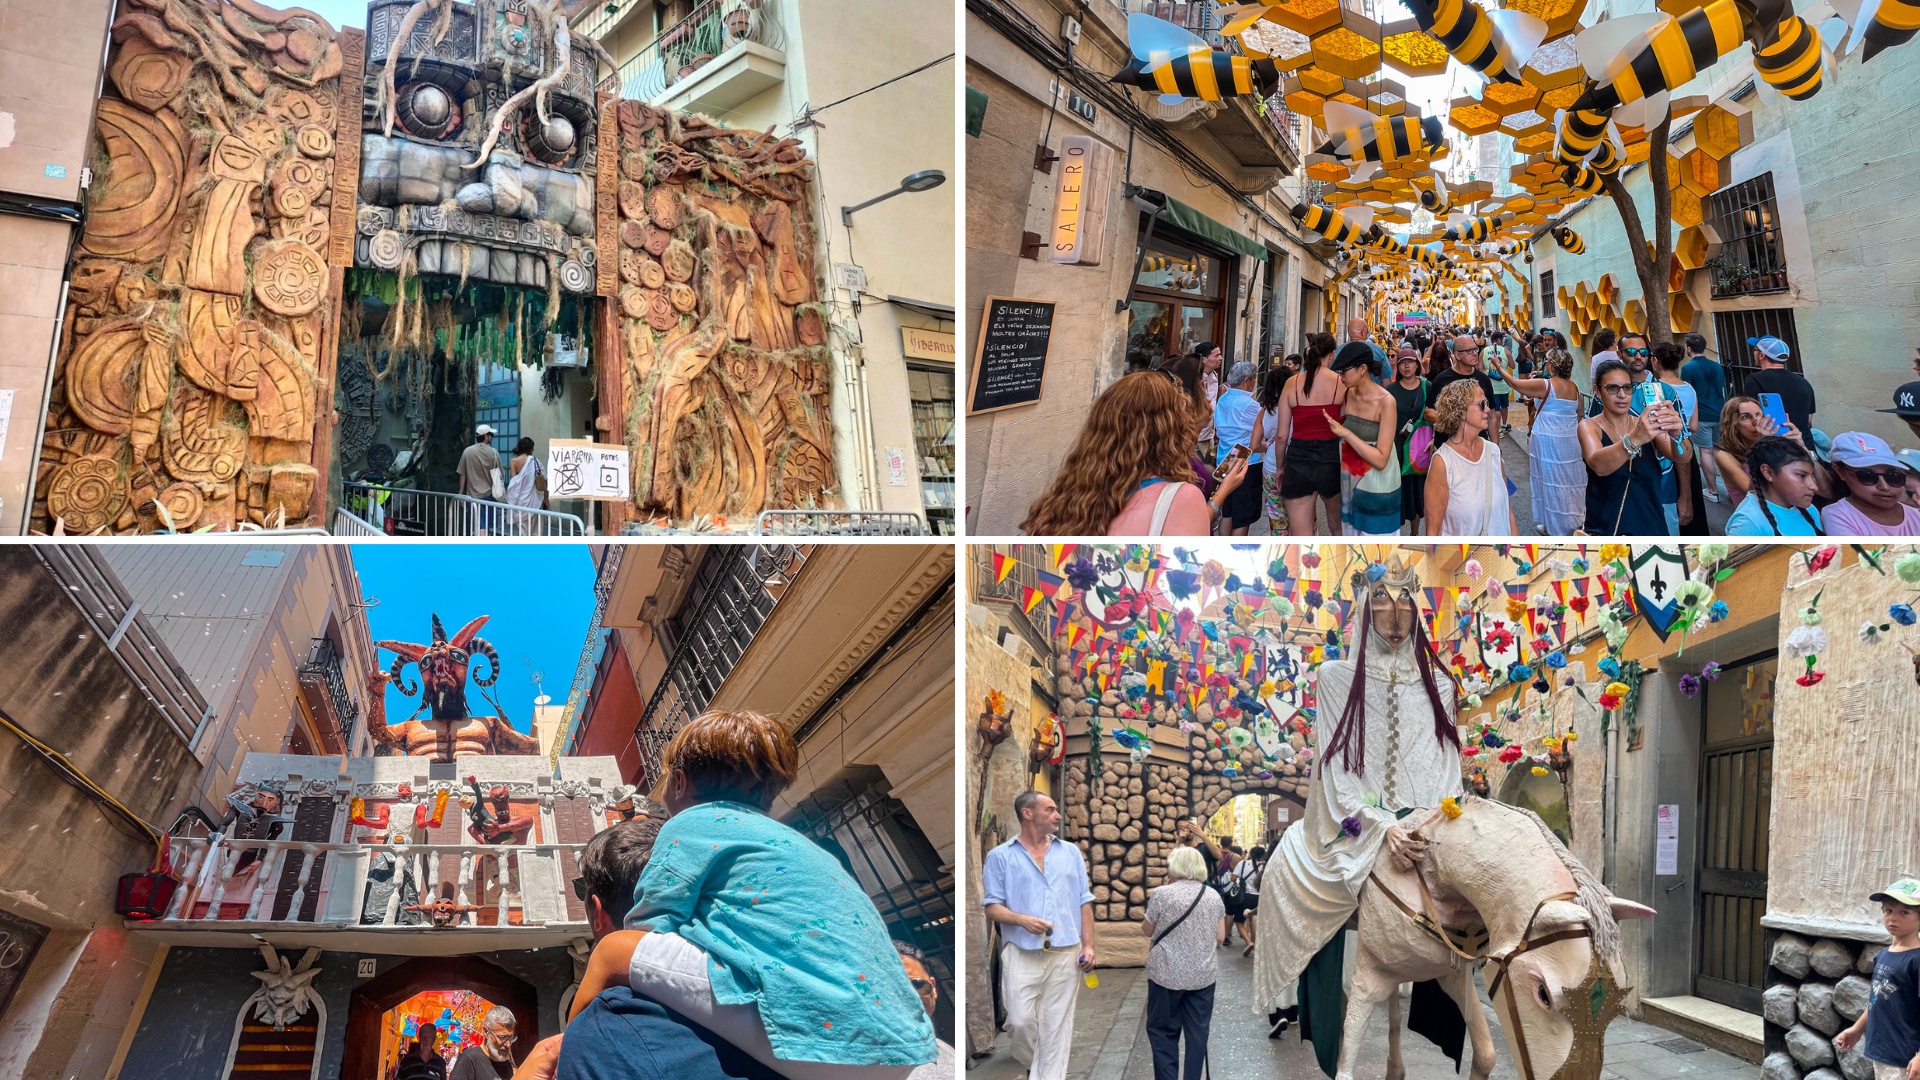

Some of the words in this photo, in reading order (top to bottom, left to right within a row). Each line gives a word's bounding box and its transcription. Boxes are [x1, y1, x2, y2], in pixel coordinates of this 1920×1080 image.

[1074, 96, 1094, 119] 10
[1056, 147, 1084, 251] SALERO
[1900, 391, 1915, 407] NY
[601, 453, 619, 461] FOTOS
[360, 961, 374, 975] 20
